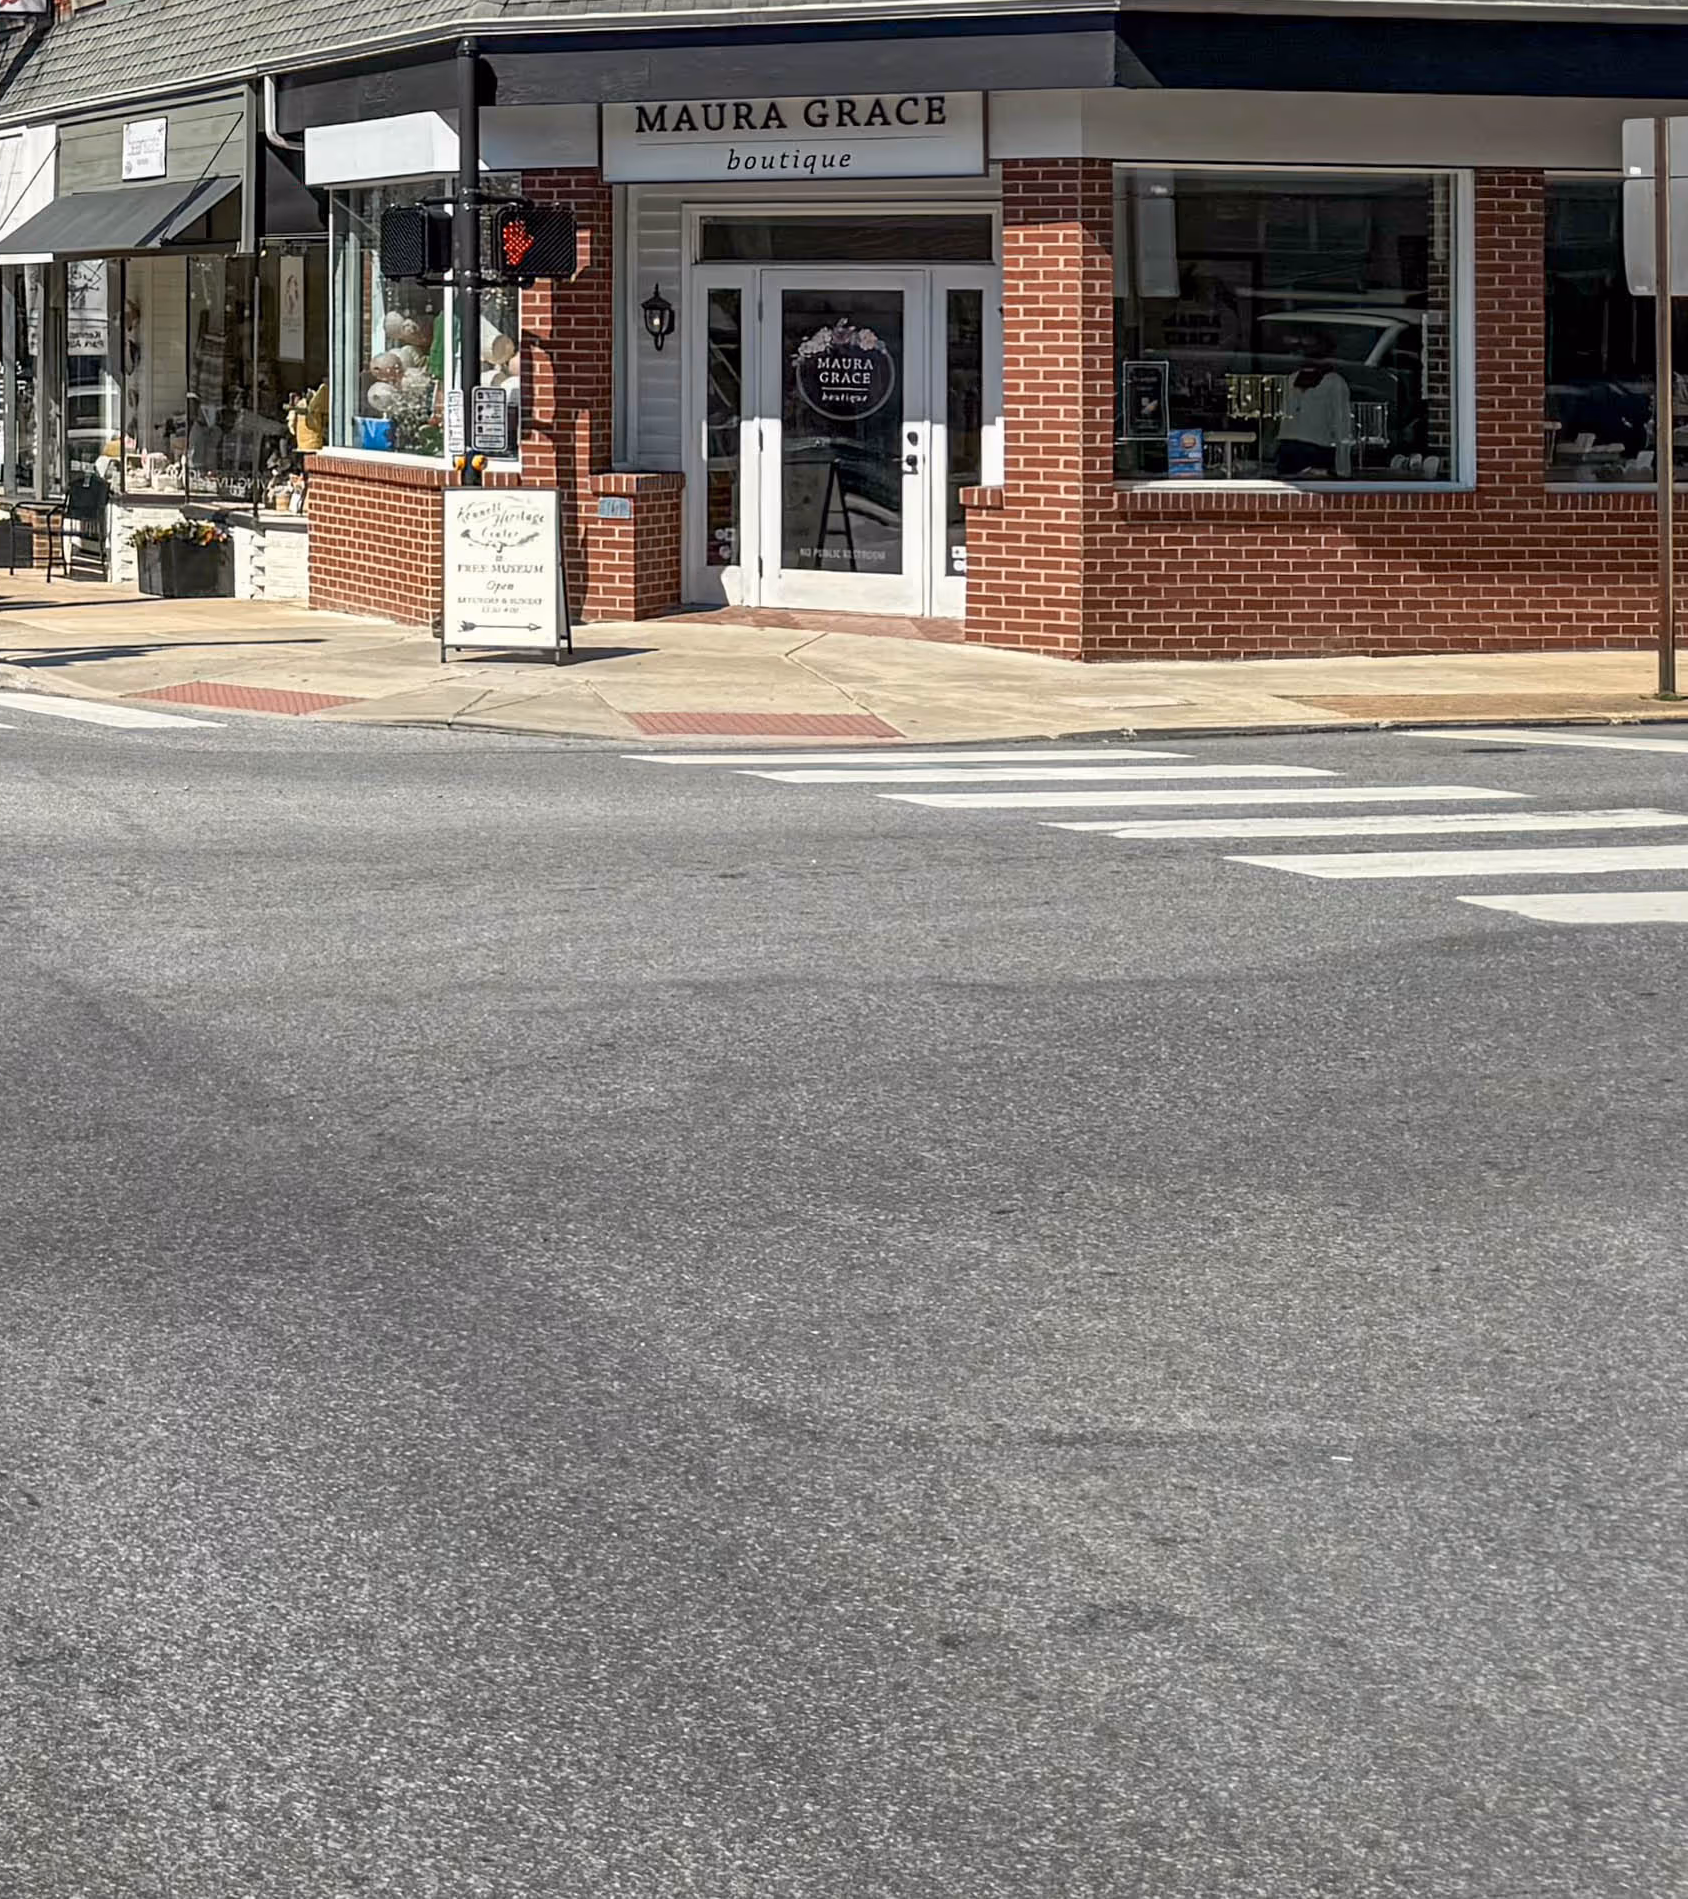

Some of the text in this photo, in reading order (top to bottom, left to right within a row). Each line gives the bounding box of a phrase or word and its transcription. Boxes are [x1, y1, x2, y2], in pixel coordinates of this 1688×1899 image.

[635, 95, 946, 134] MAURA GRACE
[727, 148, 851, 174] boutique
[817, 357, 874, 370] MAURA
[819, 372, 872, 384] GRACE
[486, 581, 514, 594] Open
